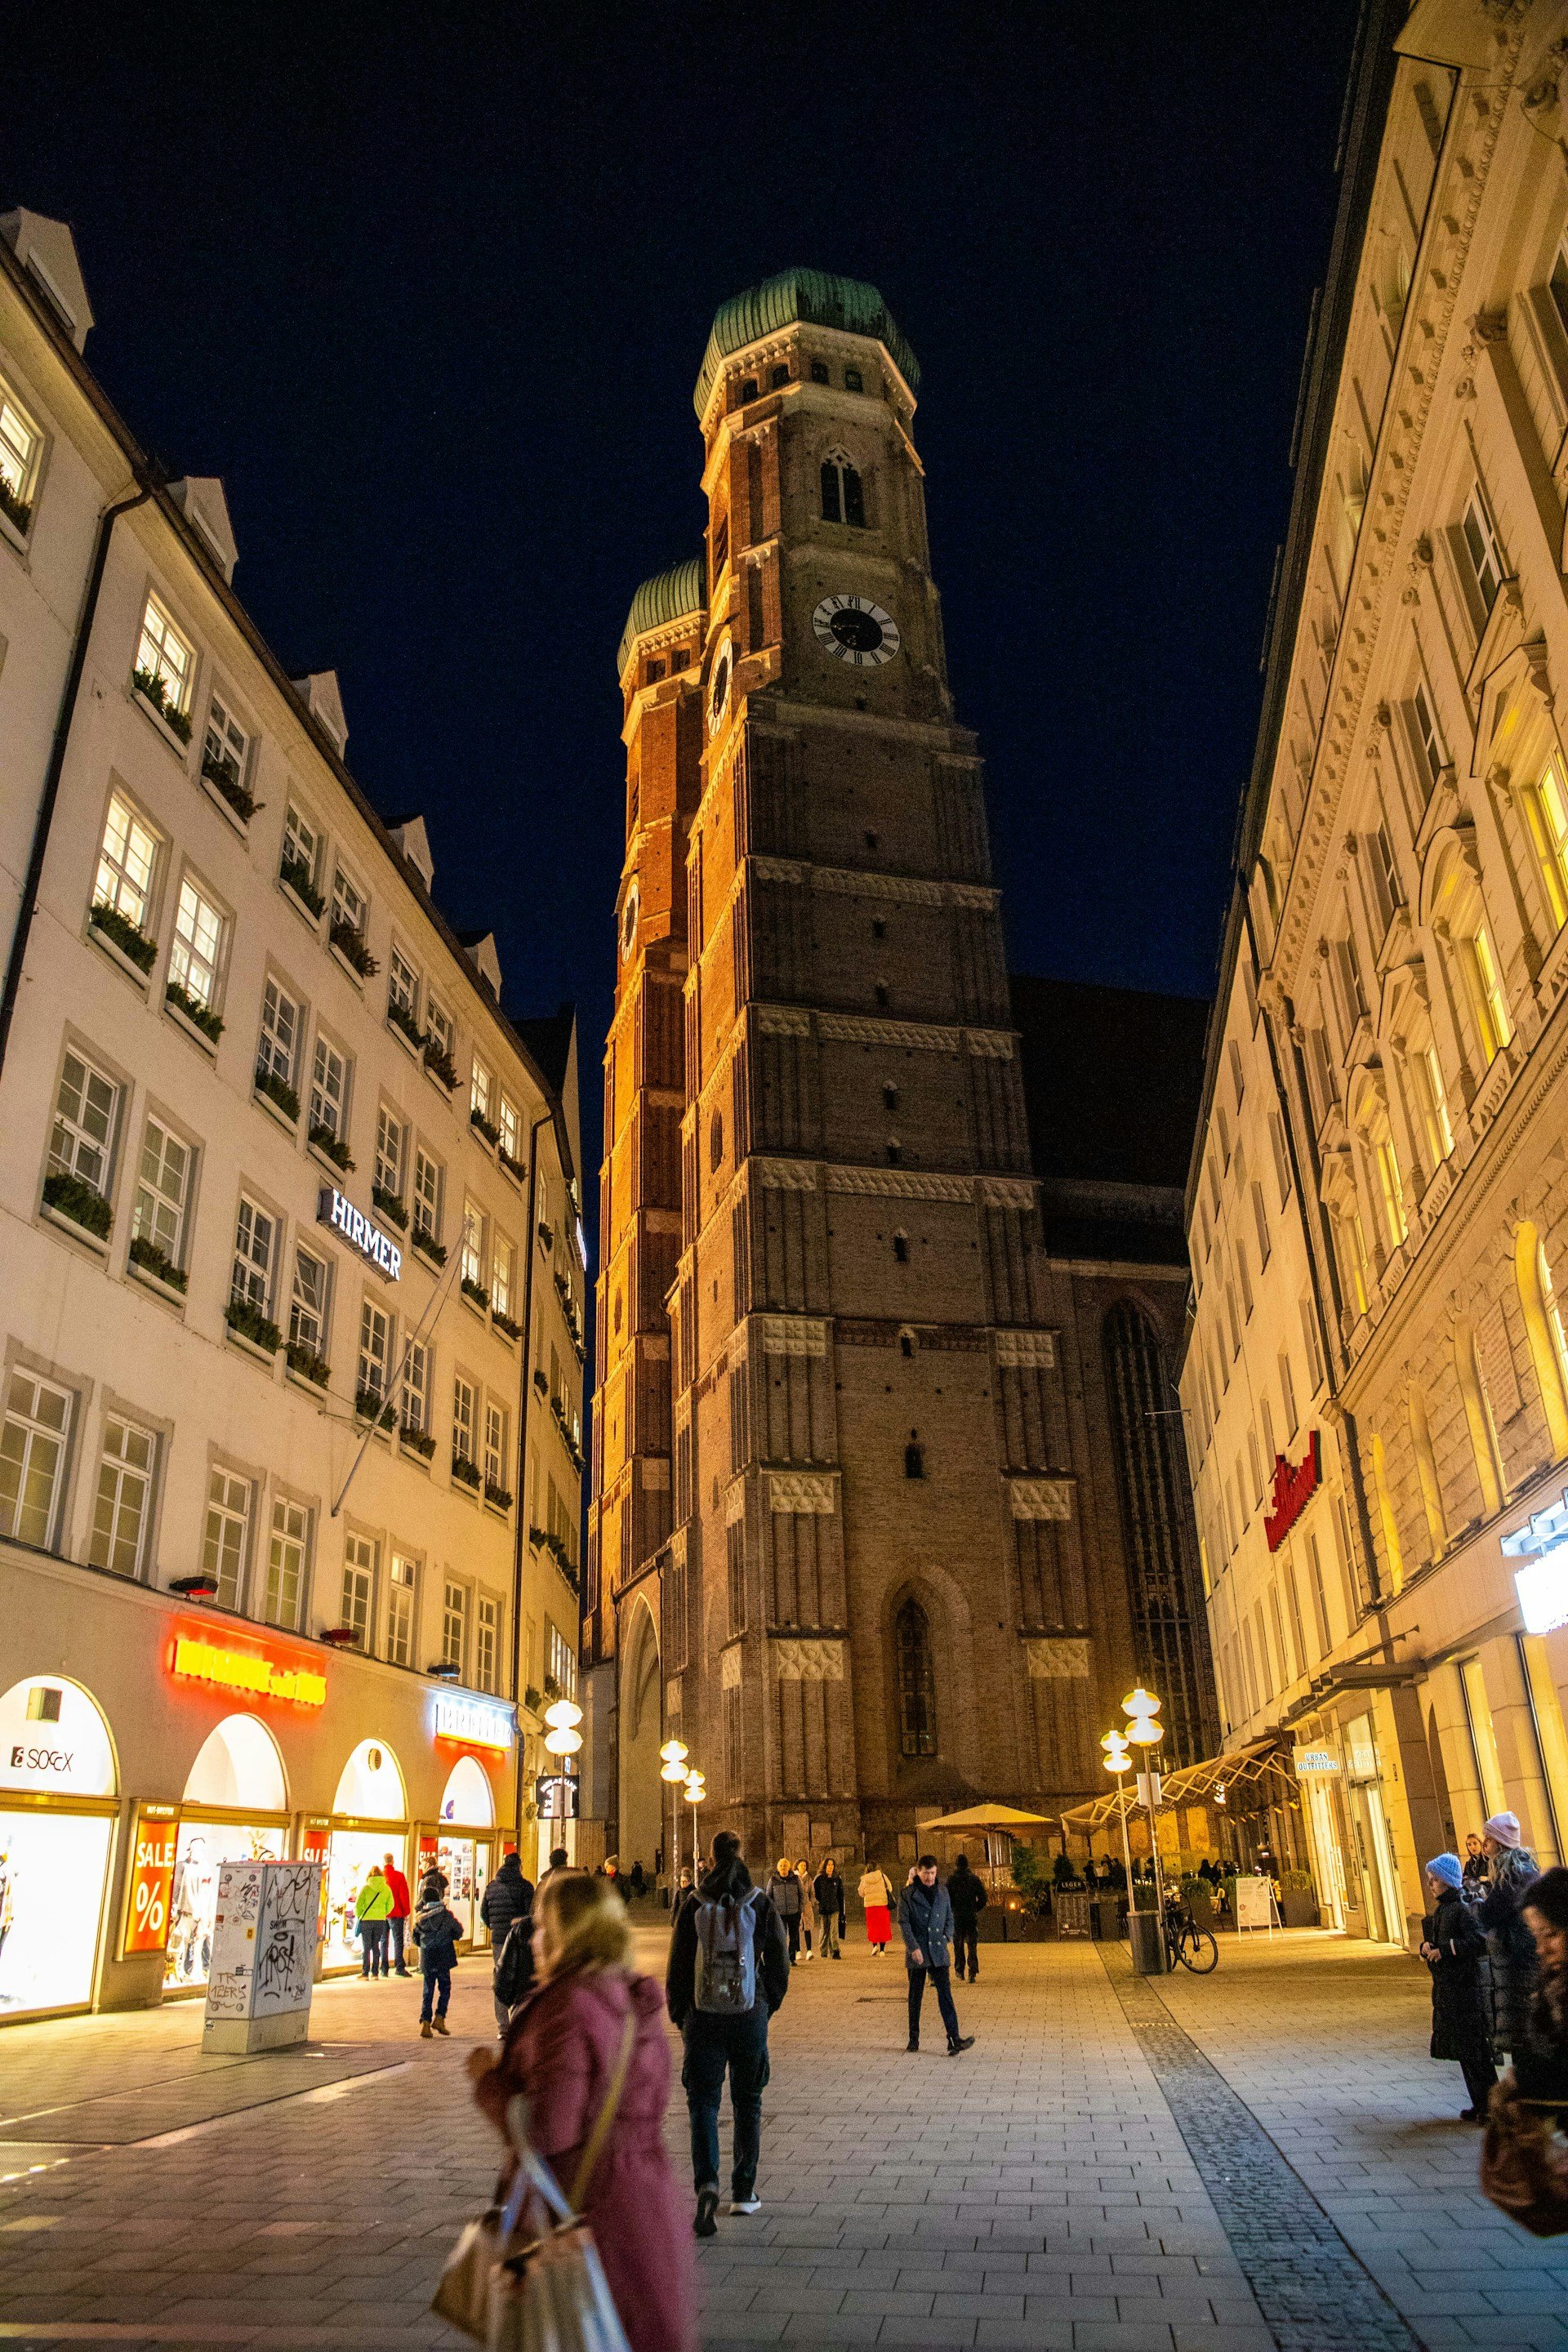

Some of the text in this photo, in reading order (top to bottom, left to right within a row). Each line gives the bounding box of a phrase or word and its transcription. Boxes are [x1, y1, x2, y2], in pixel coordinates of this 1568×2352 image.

[331, 1188, 401, 1281] HIRMER
[436, 1704, 512, 1746] BREITER
[27, 1748, 74, 1772] SOCCX
[1298, 1761, 1338, 1771] OUTFITTERS
[1305, 1753, 1328, 1762] URBAN
[136, 1842, 174, 1869] SALE
[136, 1881, 163, 1932] %
